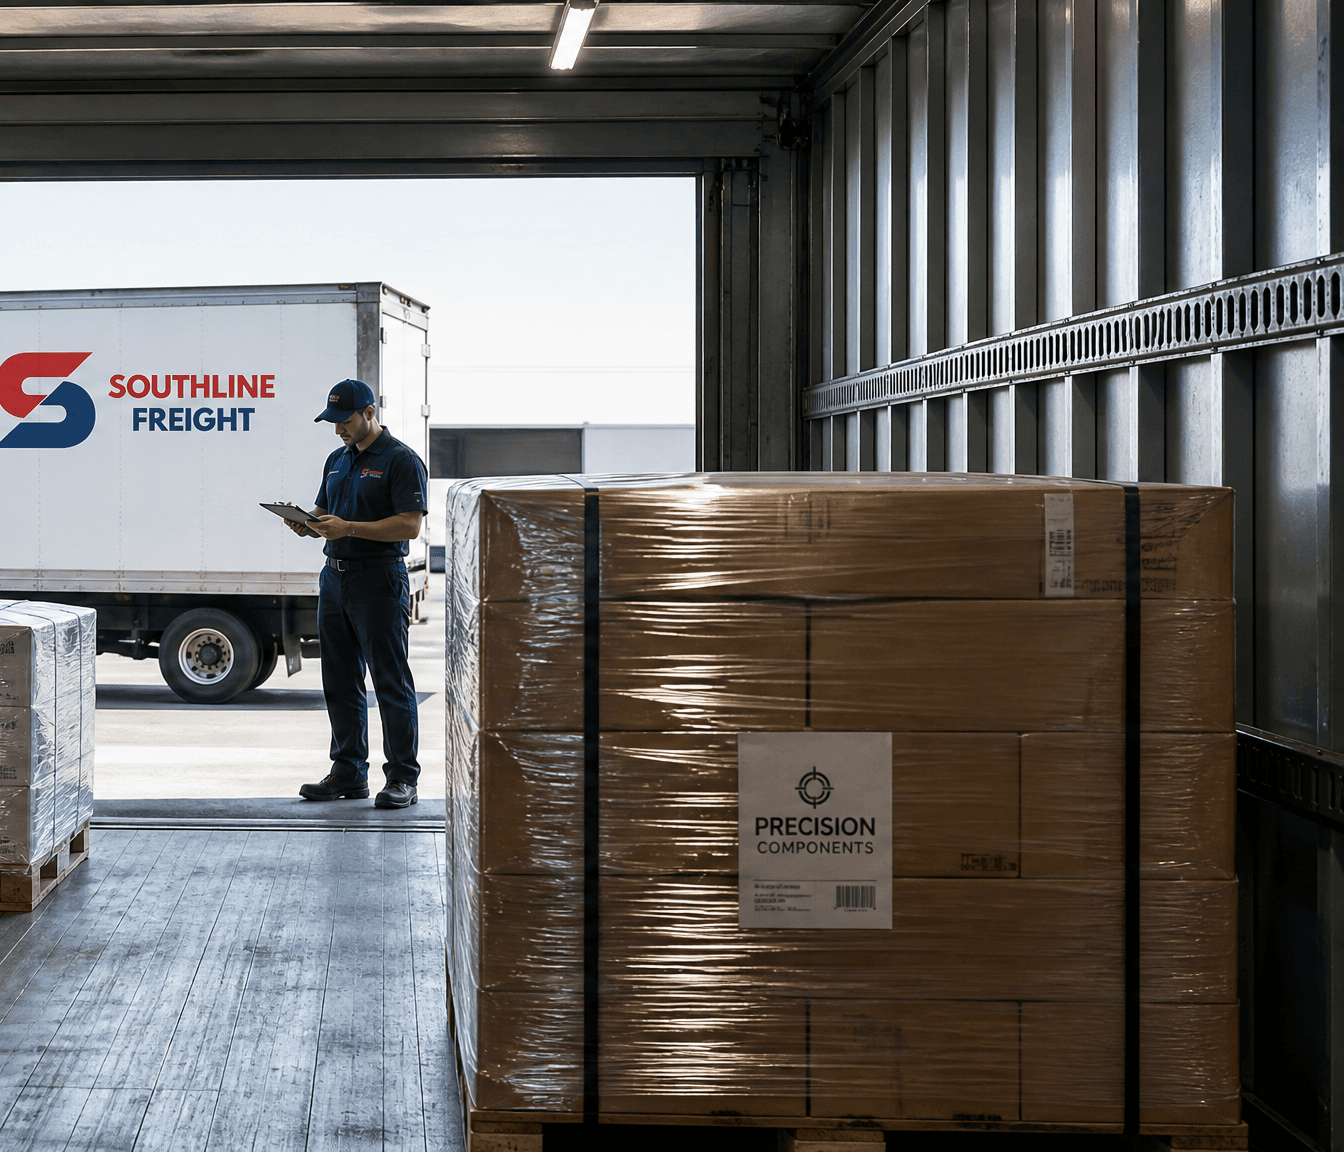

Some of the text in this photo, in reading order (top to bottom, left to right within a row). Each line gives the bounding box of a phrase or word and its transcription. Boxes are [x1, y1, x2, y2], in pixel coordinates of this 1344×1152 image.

[108, 374, 275, 399] SOUTHLINE
[133, 407, 255, 432] FREIGHT
[755, 816, 876, 836] PRECISION
[757, 841, 874, 854] COMPONENTS
